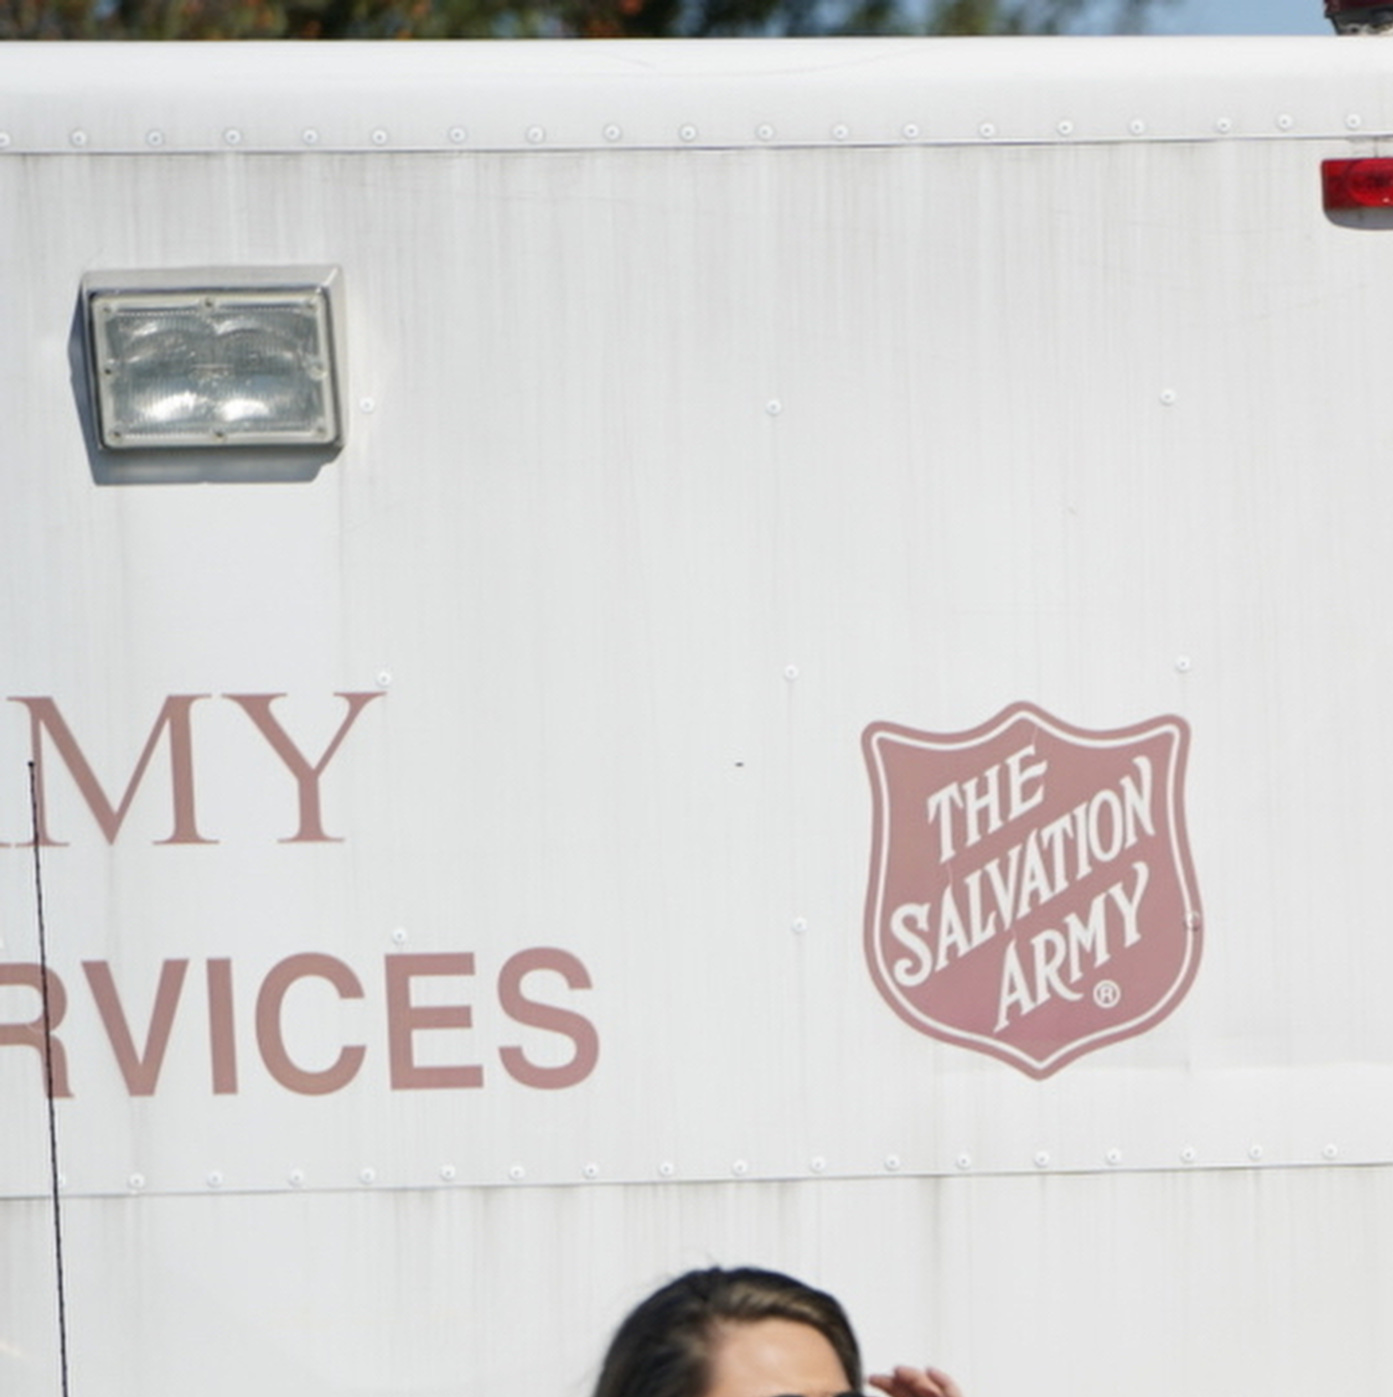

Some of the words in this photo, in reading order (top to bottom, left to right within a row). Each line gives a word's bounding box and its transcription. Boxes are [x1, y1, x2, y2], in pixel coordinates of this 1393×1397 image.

[0, 692, 387, 848] MY
[926, 745, 1048, 866] THE
[890, 755, 1156, 987] SALVATION
[994, 861, 1149, 1033] ARMY
